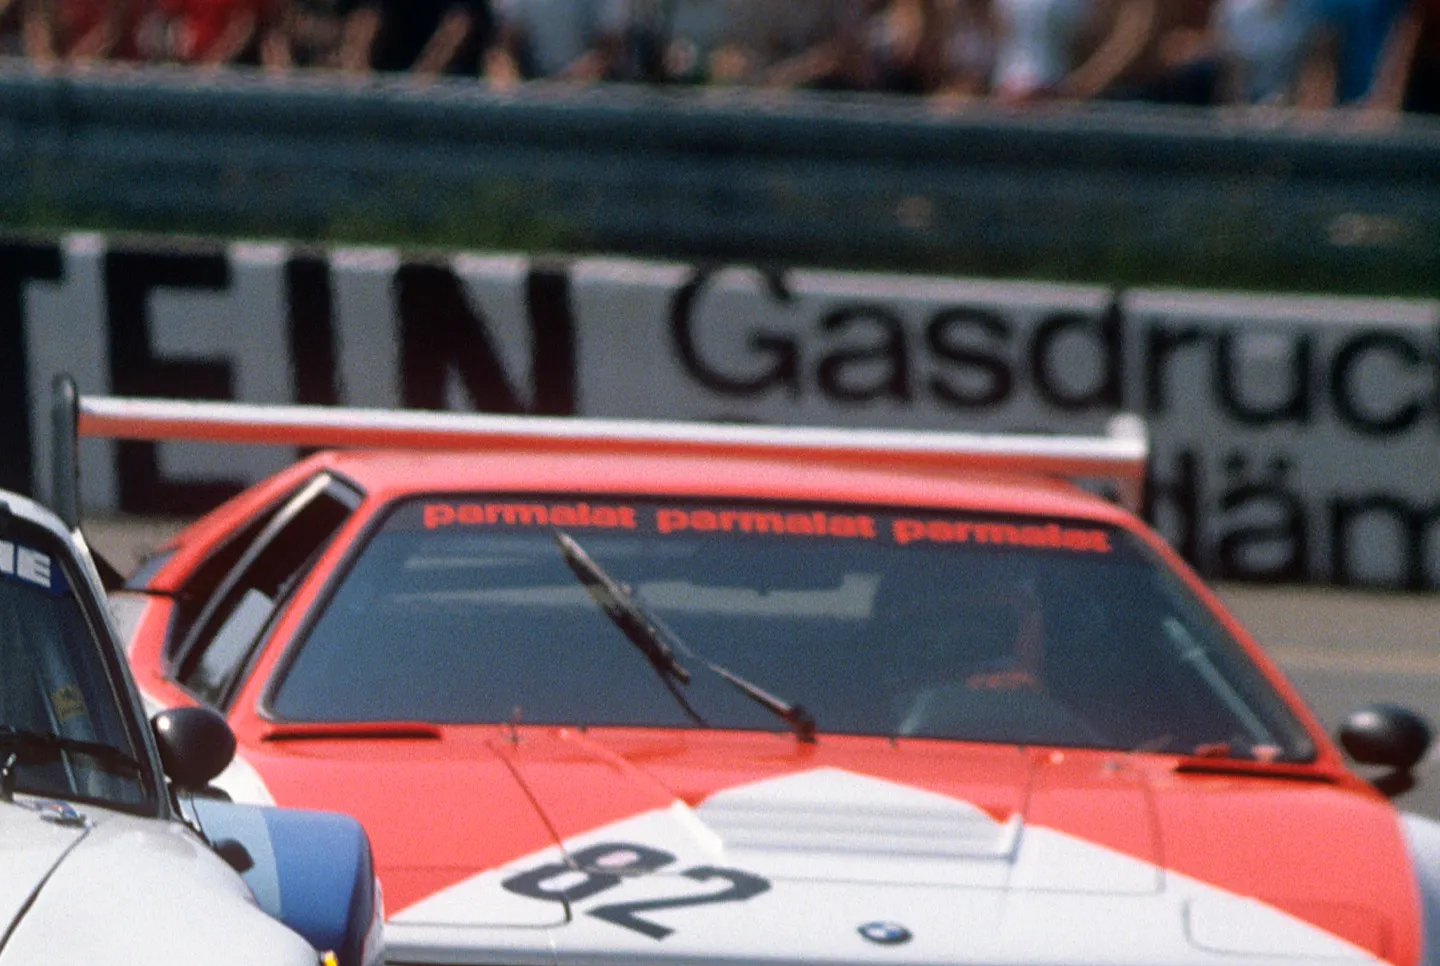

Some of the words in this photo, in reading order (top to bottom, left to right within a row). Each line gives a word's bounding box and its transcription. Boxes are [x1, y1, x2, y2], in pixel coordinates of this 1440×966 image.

[666, 260, 1440, 440] Gasdruc
[423, 503, 637, 530] parmalat
[657, 508, 876, 539] parmalat
[893, 517, 1113, 552] parmalat
[501, 842, 772, 941] 82
